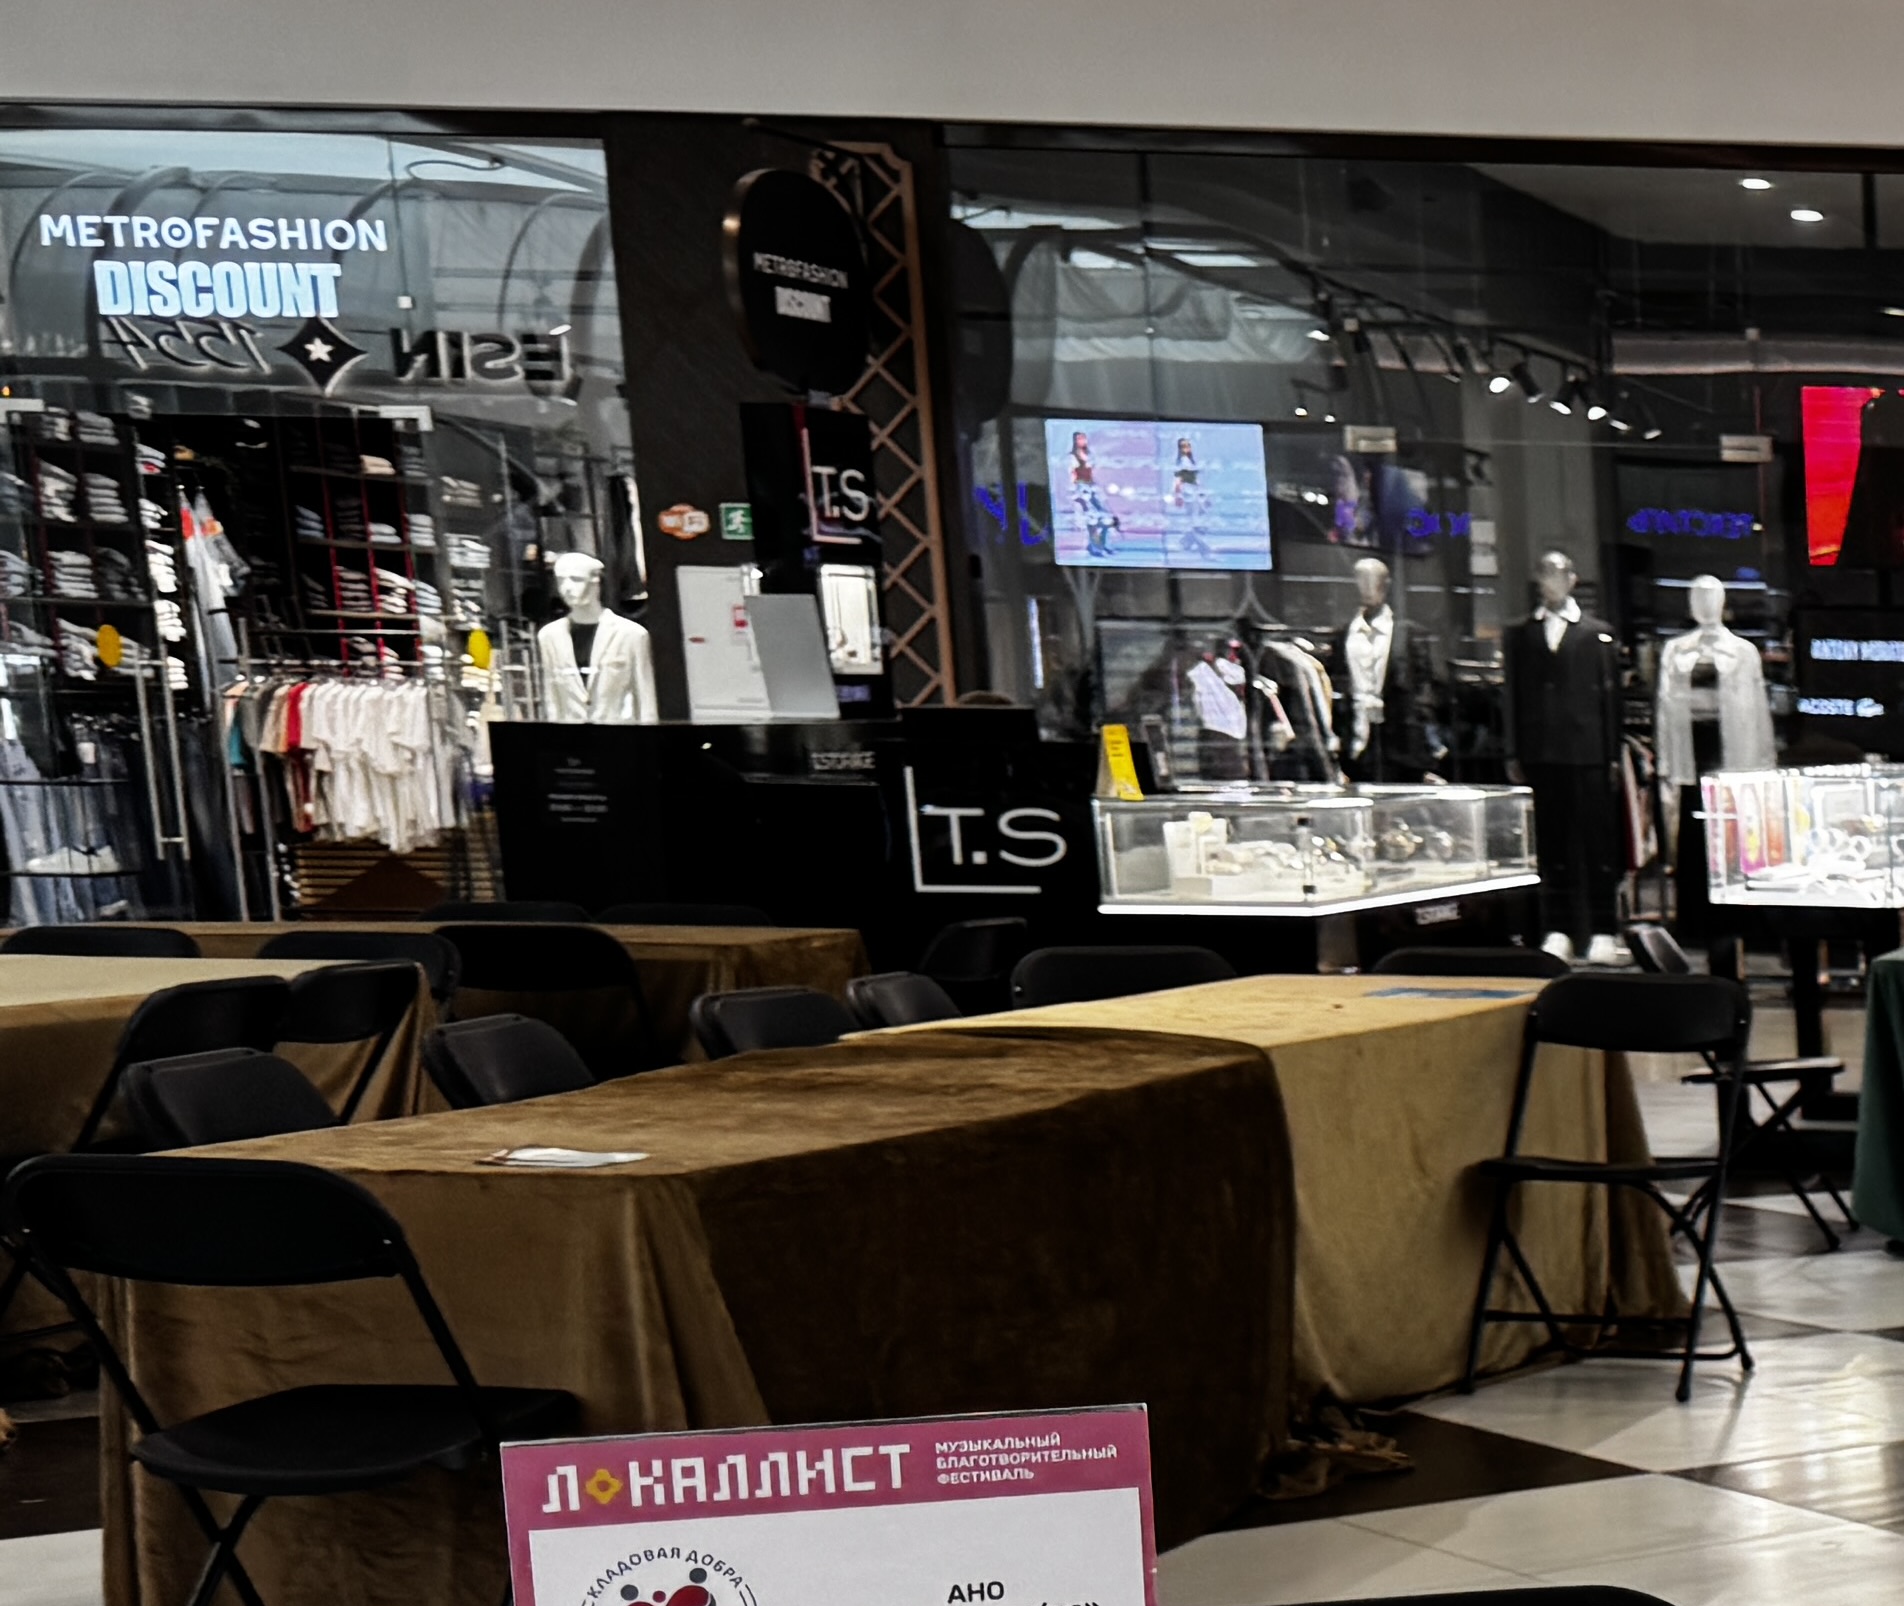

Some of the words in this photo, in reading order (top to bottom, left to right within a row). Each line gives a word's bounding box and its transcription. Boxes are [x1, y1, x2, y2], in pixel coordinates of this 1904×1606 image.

[39, 214, 388, 252] METROFASHION
[93, 259, 342, 318] DISCOUNT
[935, 1432, 1060, 1453] МУЗЫКАЛЬНЫЙ
[936, 1444, 1117, 1469] БЛАГОТВОРИТЕЛЬНЫЙ
[937, 1467, 1034, 1484] ФЕСТИВАЛЬ
[586, 1547, 681, 1599] КЛАДОВАЯ
[685, 1550, 744, 1588] ДОБРА
[947, 1580, 1005, 1604] АНО
